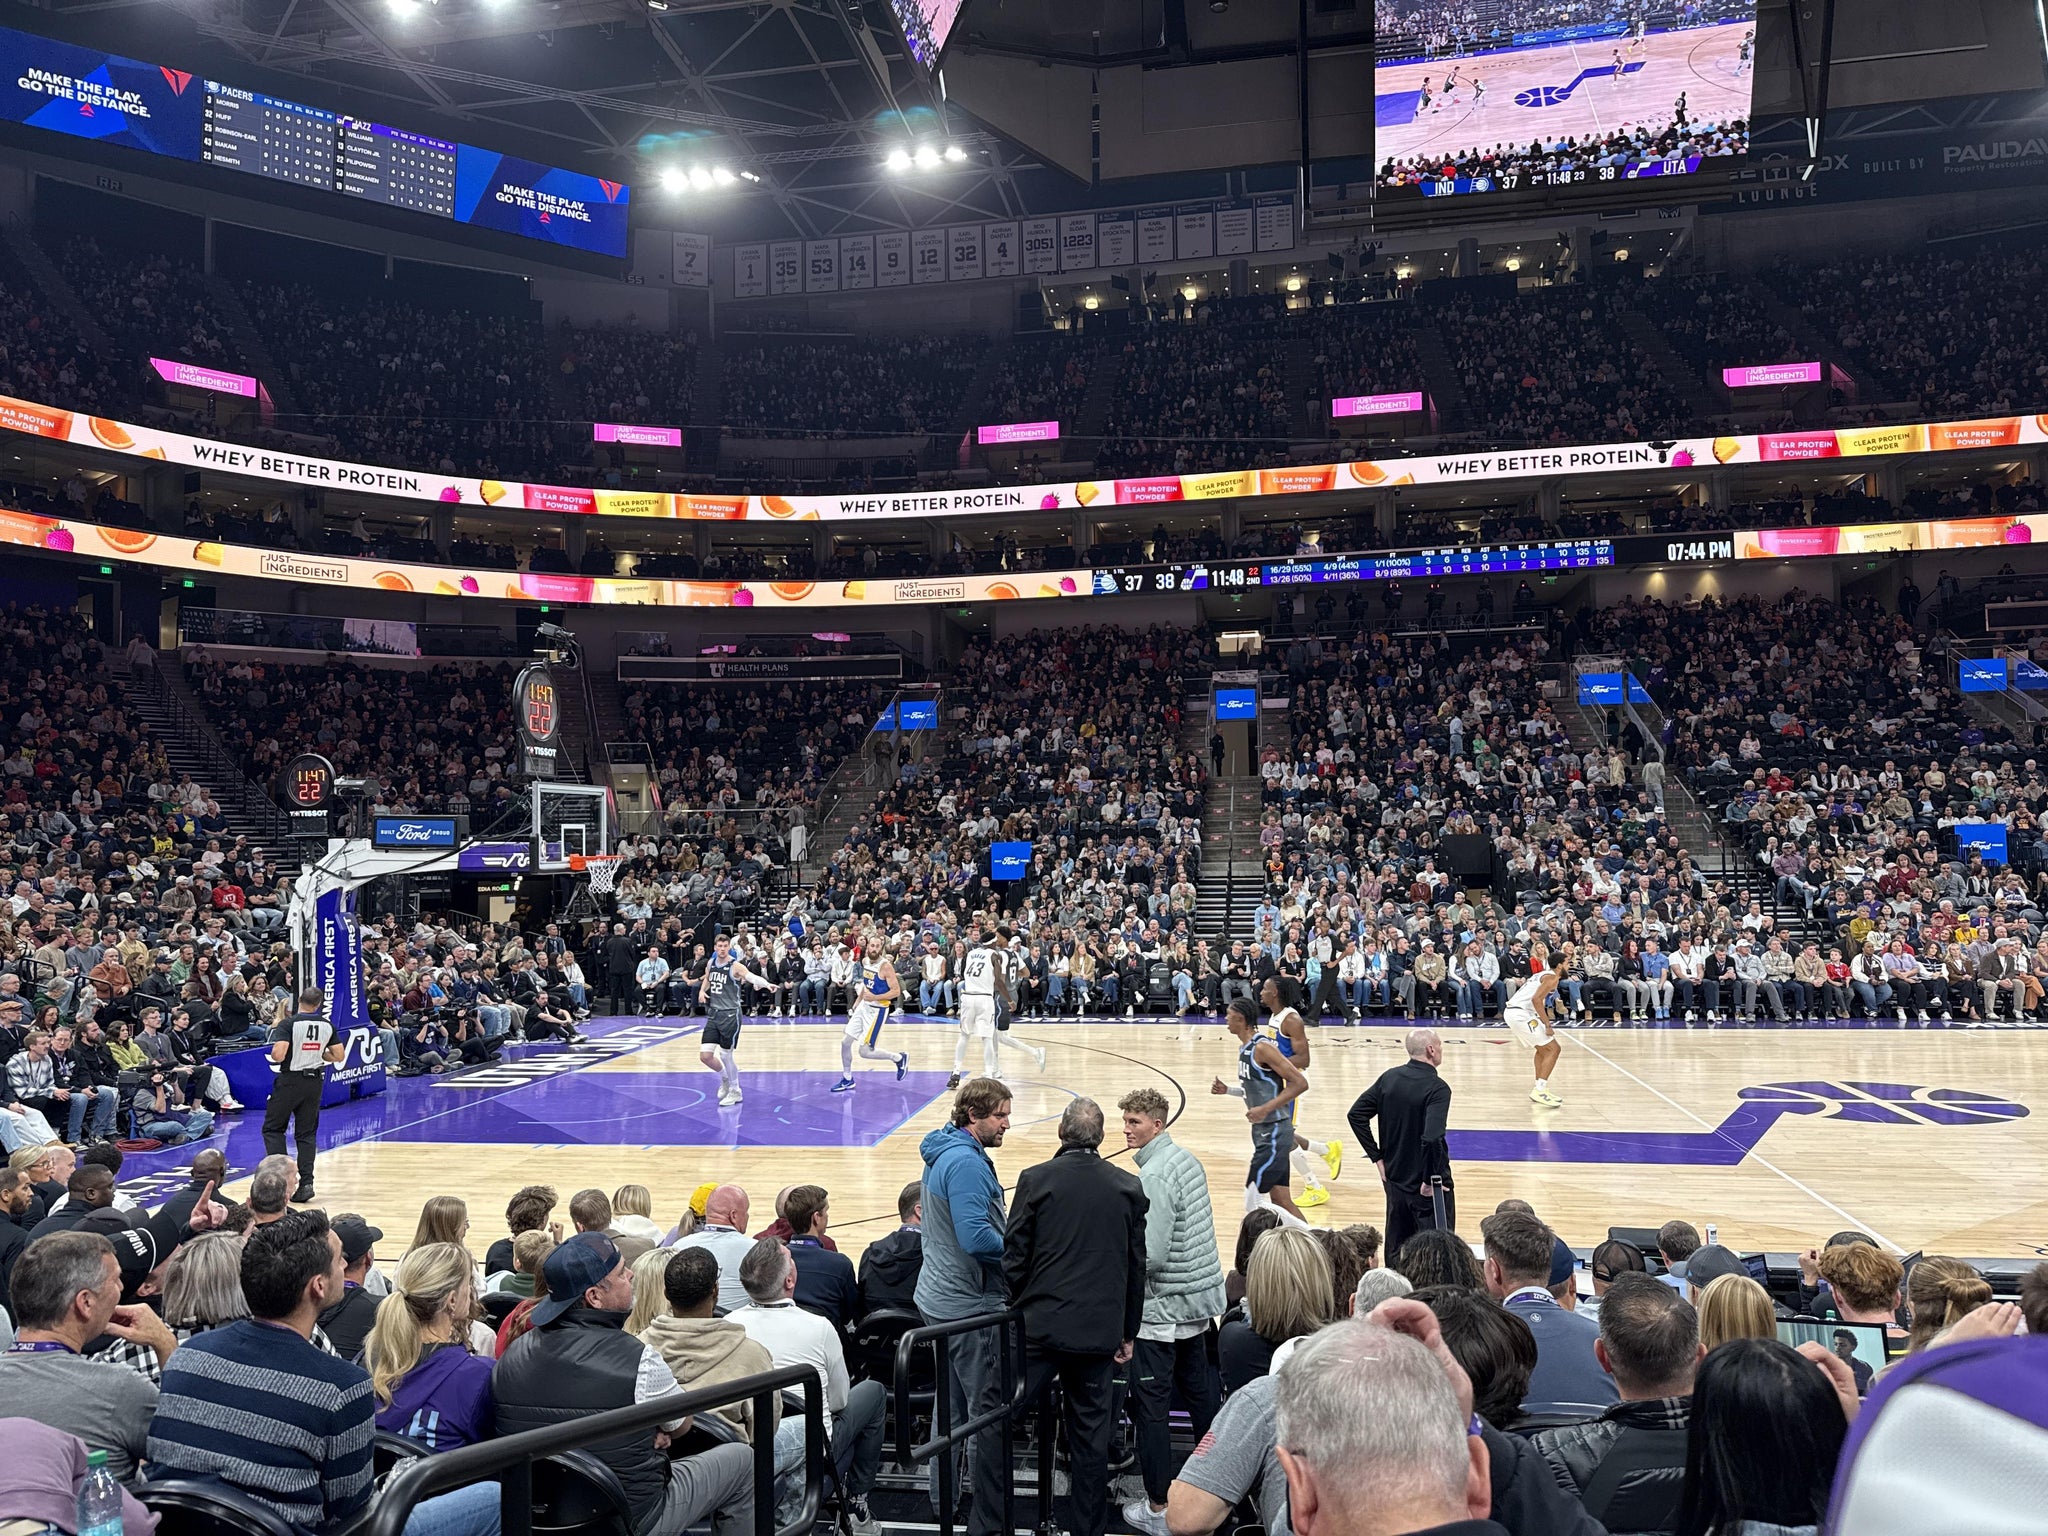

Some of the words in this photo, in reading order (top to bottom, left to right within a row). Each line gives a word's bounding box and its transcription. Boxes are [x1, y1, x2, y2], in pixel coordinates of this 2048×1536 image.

[28, 68, 72, 87] MAKE
[74, 79, 102, 95] THE
[105, 87, 142, 105] PLAY.
[222, 86, 253, 101] PACERS
[18, 77, 42, 91] GO
[45, 83, 74, 99] THE
[77, 91, 151, 118] DISTANCE.
[216, 99, 239, 109] MORRIS
[215, 127, 258, 141] ROBINSON-EARL
[347, 145, 372, 156] CLAYTON
[1864, 160, 1901, 173] BUILT
[1910, 158, 1924, 171] BY
[1944, 164, 1985, 174] Property
[1989, 159, 2044, 170] Restoration
[1435, 182, 1454, 194] IND
[1502, 175, 1517, 189] 37
[1546, 171, 1571, 185] 11:48
[1574, 171, 1584, 181] 23
[1600, 167, 1615, 180] 38
[1663, 160, 1685, 174] UTA
[345, 185, 364, 194] BAILEY
[504, 184, 535, 199] MAKE
[536, 192, 556, 205] THE
[559, 198, 585, 211] PLAY.
[496, 192, 513, 204] GO
[515, 197, 536, 209] THE
[538, 202, 591, 222] DISTANCE.
[1025, 237, 1055, 251] 3051
[1063, 234, 1093, 248] 1223
[920, 249, 938, 265] 12
[955, 245, 976, 262] 32
[997, 242, 1007, 258] 4
[685, 252, 696, 268] 7
[811, 259, 833, 274] 53
[848, 255, 866, 272] 14
[888, 252, 898, 268] 9
[747, 264, 754, 279] 1
[775, 260, 797, 277] 35
[179, 373, 239, 390] INGREDIENTS
[1749, 371, 1805, 381] INGREDIENTS
[1355, 401, 1407, 411] INGREDIENTS
[2, 417, 40, 434] POWDER
[18, 412, 55, 429] PROTEIN
[617, 431, 667, 442] INGREDIENTS
[1853, 438, 1877, 448] CLEAR
[1878, 433, 1910, 443] PROTEIN
[1944, 431, 1970, 439] CLEAR
[1973, 430, 2004, 438] PROTEIN
[1957, 438, 1991, 446] POWDER
[1770, 441, 1800, 449] CLEAR
[1802, 440, 1832, 448] PROTEIN
[1867, 442, 1899, 452] POWDER
[1783, 448, 1819, 457] POWDER
[193, 445, 254, 467] WHEY
[261, 457, 330, 481] BETTER
[338, 469, 422, 492] PROTEIN.
[1437, 459, 1492, 476] WHEY
[1498, 454, 1563, 471] BETTER
[1570, 449, 1653, 466] PROTEIN.
[1124, 485, 1150, 493] CLEAR
[1152, 485, 1178, 493] PROTEIN
[1195, 483, 1216, 491] CLEAR
[1217, 478, 1244, 488] PROTEIN
[1206, 487, 1234, 496] POWDER
[534, 492, 562, 502] CLEAR
[563, 494, 591, 505] PROTEIN
[610, 500, 631, 508] CLEAR
[632, 499, 659, 507] PROTEIN
[840, 499, 887, 513] WHEY
[892, 497, 948, 511] BETTER
[954, 492, 1025, 508] PROTEIN.
[1135, 493, 1166, 501] POWDER
[546, 502, 579, 512] POWDER
[688, 503, 707, 511] CLEAR
[708, 504, 736, 512] PROTEIN
[697, 510, 725, 518] POWDER
[265, 553, 291, 564] JUST
[1667, 543, 1706, 561] 07:44
[1709, 541, 1732, 559] PM
[1270, 565, 1291, 573] 16/29
[1292, 563, 1312, 573] (55%)
[1324, 562, 1338, 570] 4/9
[1339, 561, 1359, 570] (44%)
[1385, 558, 1411, 567] (100%)
[1463, 554, 1469, 562] 9
[1482, 553, 1488, 561] 9
[1559, 549, 1567, 557] 10
[1576, 548, 1590, 556] 135
[1596, 546, 1609, 555] 127
[266, 563, 343, 579] INGREDIENTS
[1248, 567, 1258, 575] 22
[1270, 575, 1291, 584] 13/26
[1291, 573, 1312, 583] (50%)
[1323, 572, 1338, 580] 4/11
[1339, 571, 1360, 580] (36%)
[1375, 569, 1389, 577] 8/9
[1390, 568, 1411, 577] (89%)
[1443, 565, 1452, 574] 10
[1462, 564, 1470, 572] 13
[1481, 563, 1490, 571] 10
[1560, 559, 1568, 567] 14
[1577, 557, 1590, 566] 127
[1596, 556, 1609, 565] 135
[1125, 575, 1143, 591] 37
[1155, 573, 1175, 590] 38
[1212, 569, 1244, 587] 11:48
[1246, 577, 1260, 585] 2ND
[898, 582, 919, 590] JUST
[899, 588, 961, 598] INGREDIENTS
[728, 664, 759, 672] HEALTH
[530, 683, 553, 703] 11:47
[1591, 685, 1609, 694] Ford
[1227, 700, 1244, 708] Ford
[530, 702, 551, 733] 22
[534, 747, 557, 757] TISSOT
[298, 769, 325, 782] 11:47
[299, 784, 320, 800] 22
[396, 824, 432, 841] Ford
[1002, 857, 1020, 866] Ford
[324, 918, 335, 957] FIRST
[343, 916, 356, 955] FIRST
[966, 962, 985, 977] 43
[710, 972, 727, 984] UTAH
[322, 960, 335, 1021] AMERICA
[346, 956, 359, 1019] AMERICA
[711, 982, 723, 994] 22
[307, 1025, 319, 1040] 41
[331, 1067, 361, 1083] AMERICA
[363, 1062, 382, 1074] FIRST
